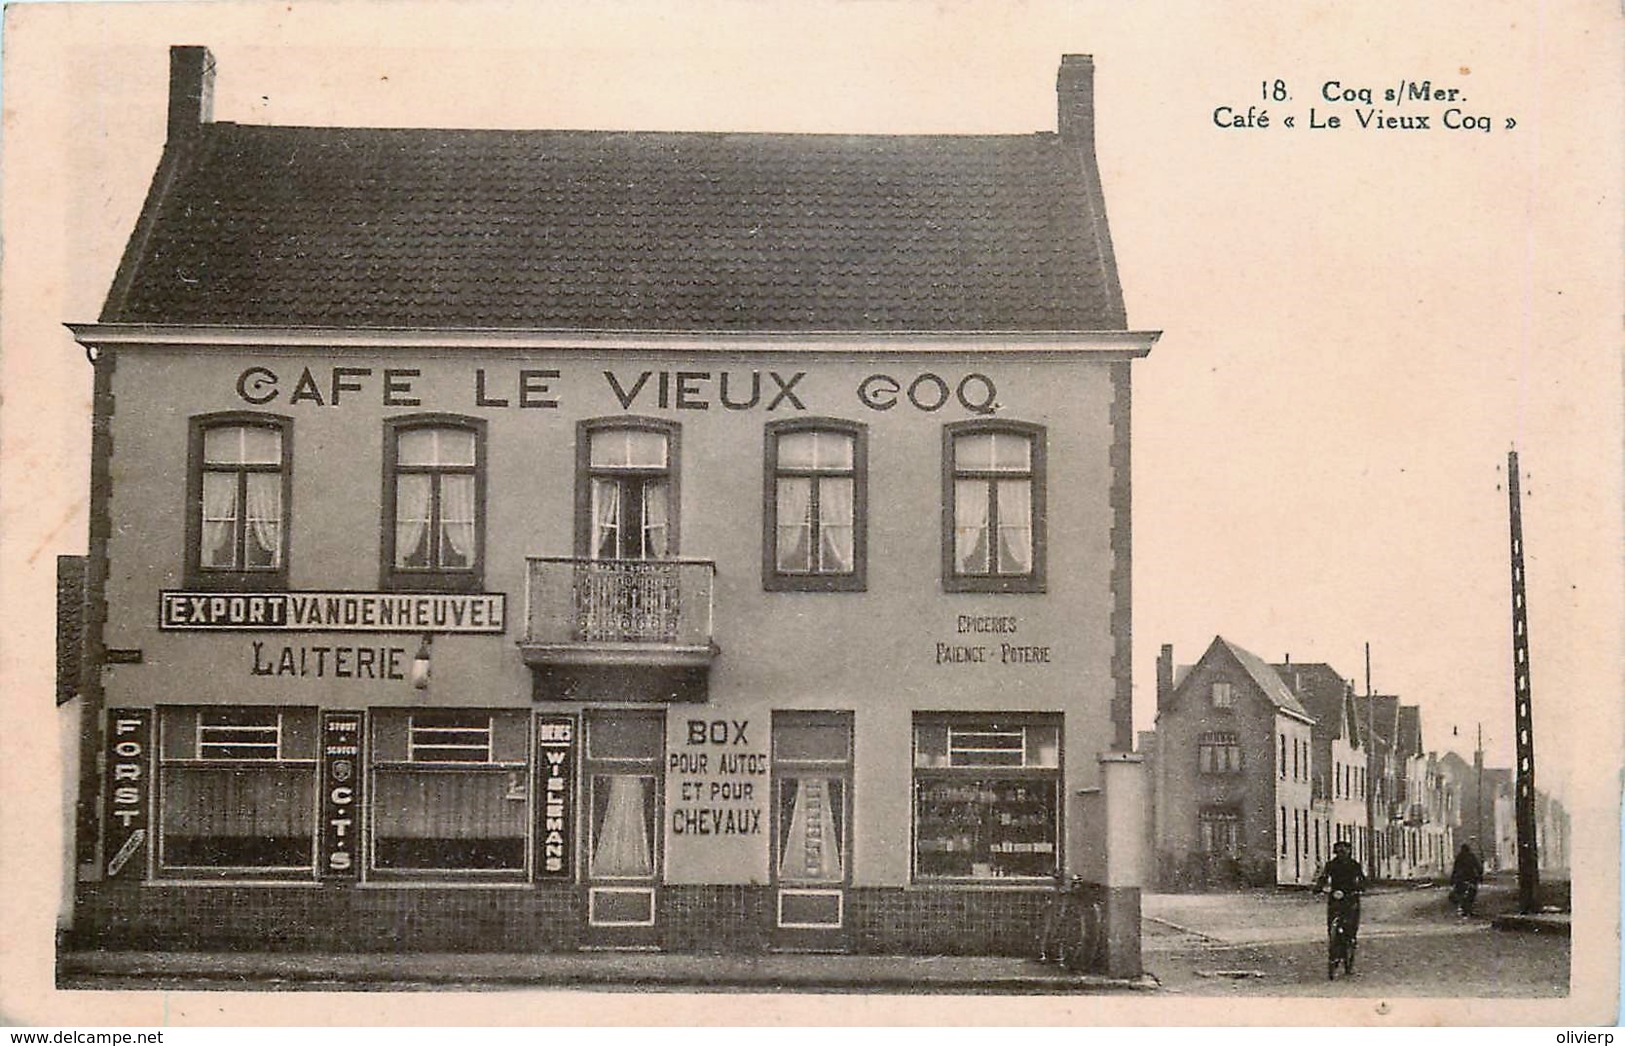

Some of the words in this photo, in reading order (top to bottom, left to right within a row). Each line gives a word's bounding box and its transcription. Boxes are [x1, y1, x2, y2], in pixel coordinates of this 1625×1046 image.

[236, 366, 422, 407] CAFE
[476, 369, 562, 409] LE
[603, 370, 807, 411] VIEUX
[857, 373, 1003, 415] COQ
[170, 597, 285, 623] EXPORT
[291, 598, 501, 626] VANDENHEUVEL
[250, 640, 405, 680] LAITERIE
[687, 720, 749, 745] BOX
[114, 719, 142, 827] FORST
[670, 753, 707, 774] POUR
[719, 753, 767, 774] AUTOS
[682, 782, 702, 801] ET
[711, 782, 753, 801] POUR
[673, 808, 761, 835] CHEVAUX
